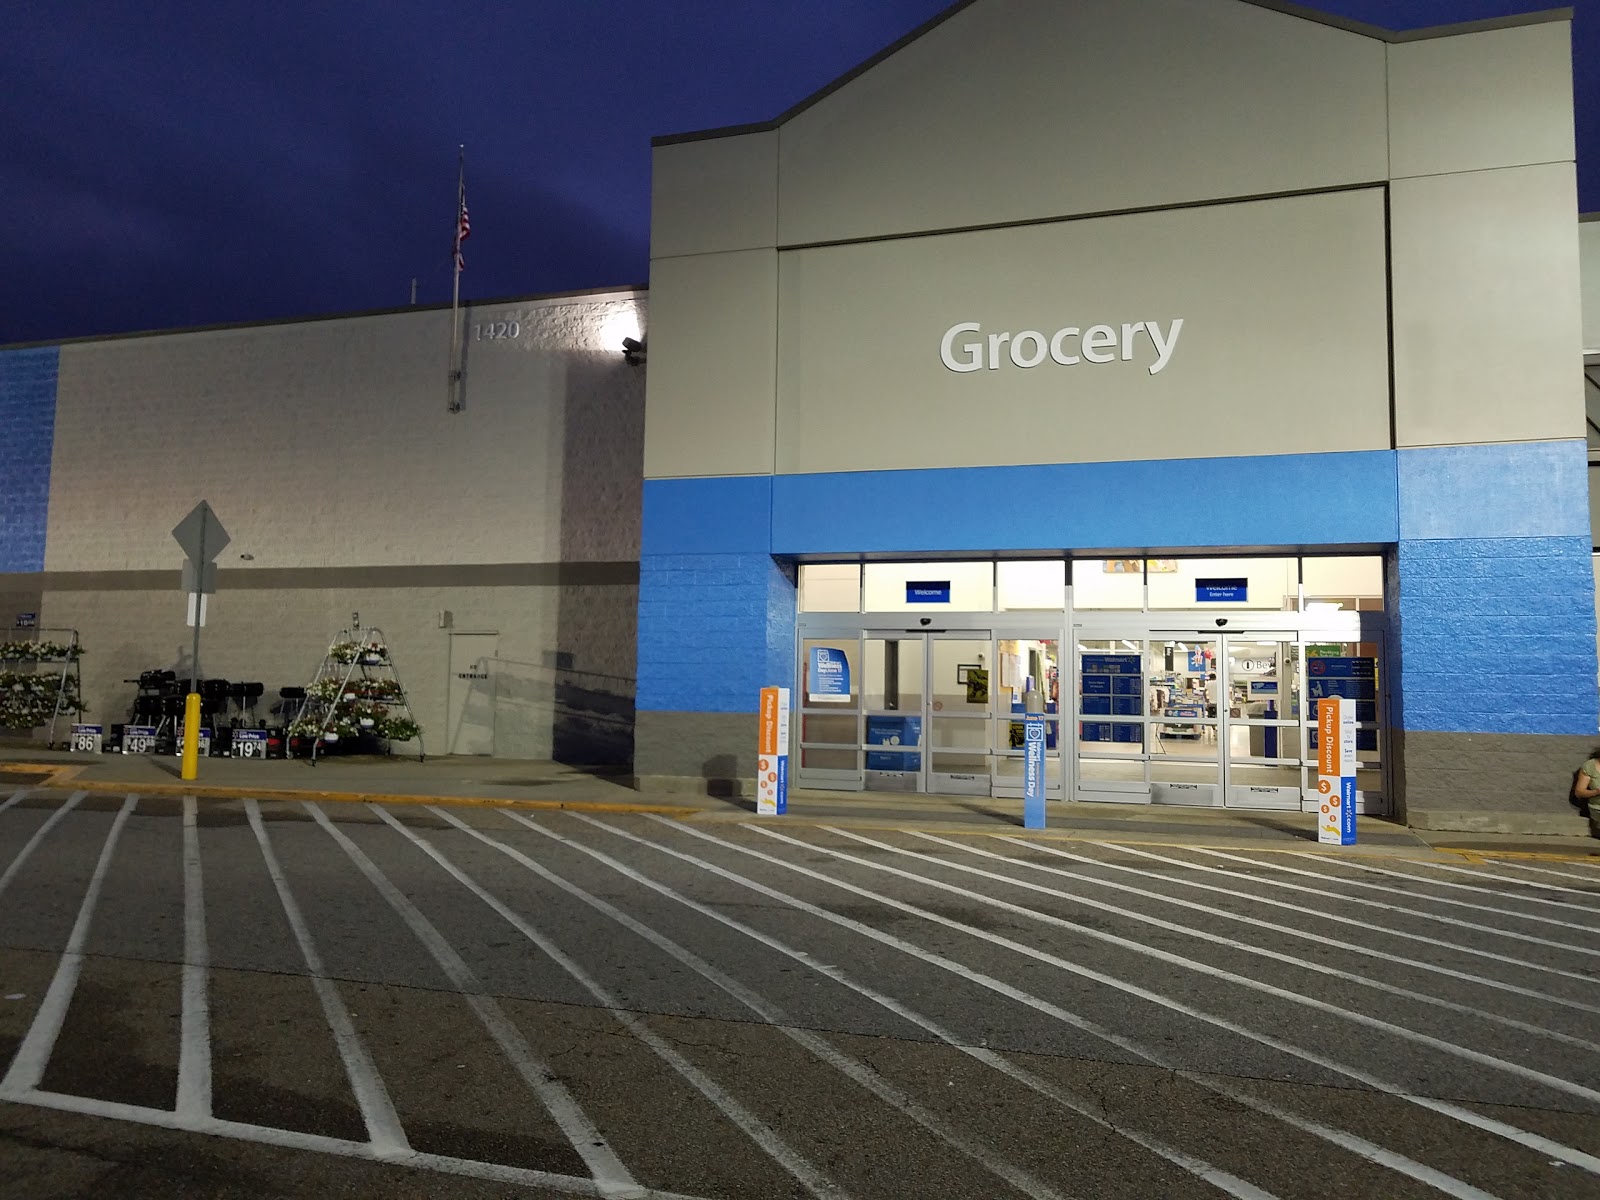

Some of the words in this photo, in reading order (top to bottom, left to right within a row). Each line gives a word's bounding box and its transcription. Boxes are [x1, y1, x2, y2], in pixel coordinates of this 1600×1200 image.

[474, 320, 520, 341] 1420
[940, 318, 1184, 376] Grocery
[765, 694, 774, 719] Pickup
[1324, 706, 1333, 735] Pickup
[766, 720, 774, 753] Discount
[1028, 742, 1037, 781] Wellness
[1326, 736, 1334, 773] Discount
[1027, 781, 1036, 797] Day
